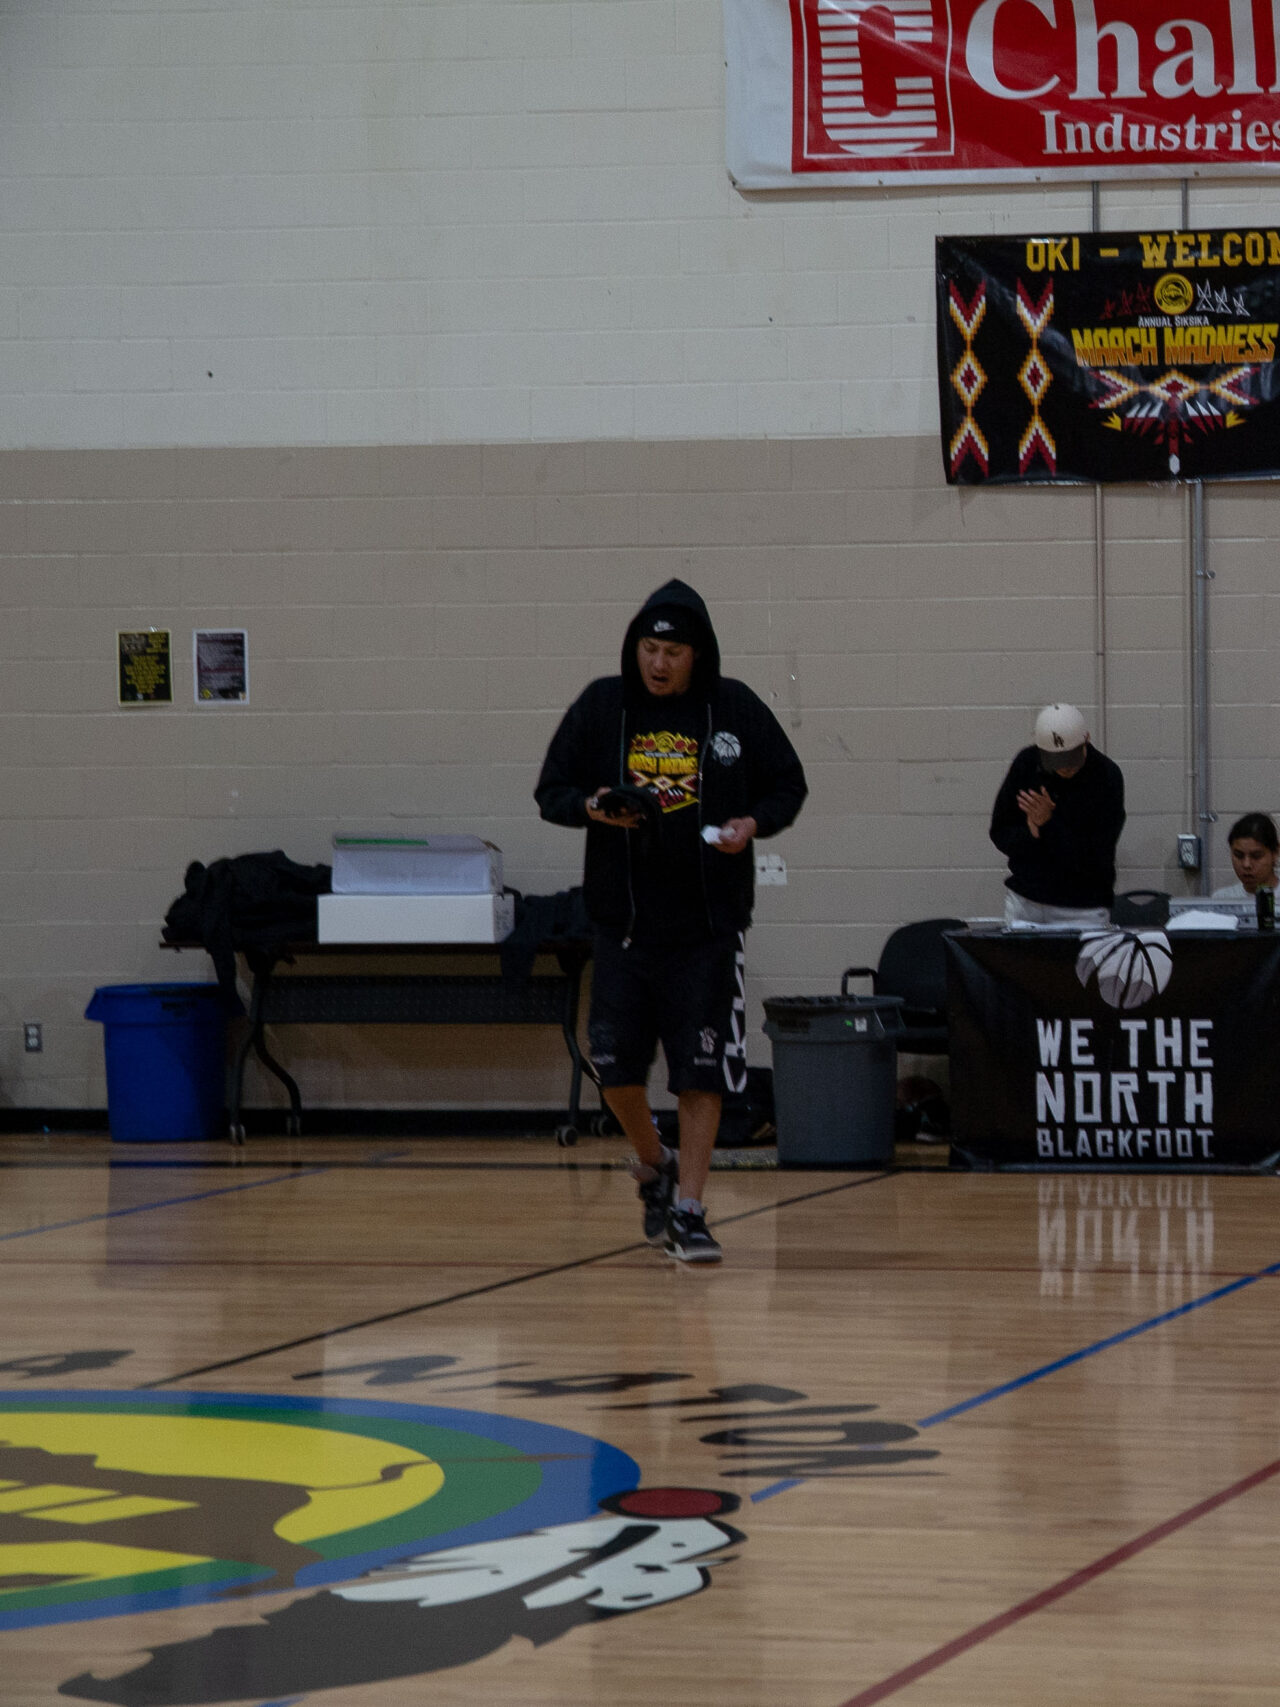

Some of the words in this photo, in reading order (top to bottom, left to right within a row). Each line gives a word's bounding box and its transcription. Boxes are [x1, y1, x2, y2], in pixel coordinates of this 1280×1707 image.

[1025, 235, 1080, 273] OKI
[1138, 315, 1172, 328] ANNUAL
[1174, 315, 1210, 327] SIKSIKA
[1071, 327, 1159, 368] MARCH
[1163, 323, 1279, 366] MADNESS
[1035, 1017, 1095, 1068] WE
[1119, 1016, 1215, 1068] THE
[1035, 1070, 1215, 1124] NORTH
[1036, 1127, 1215, 1159] BLACKFOOT
